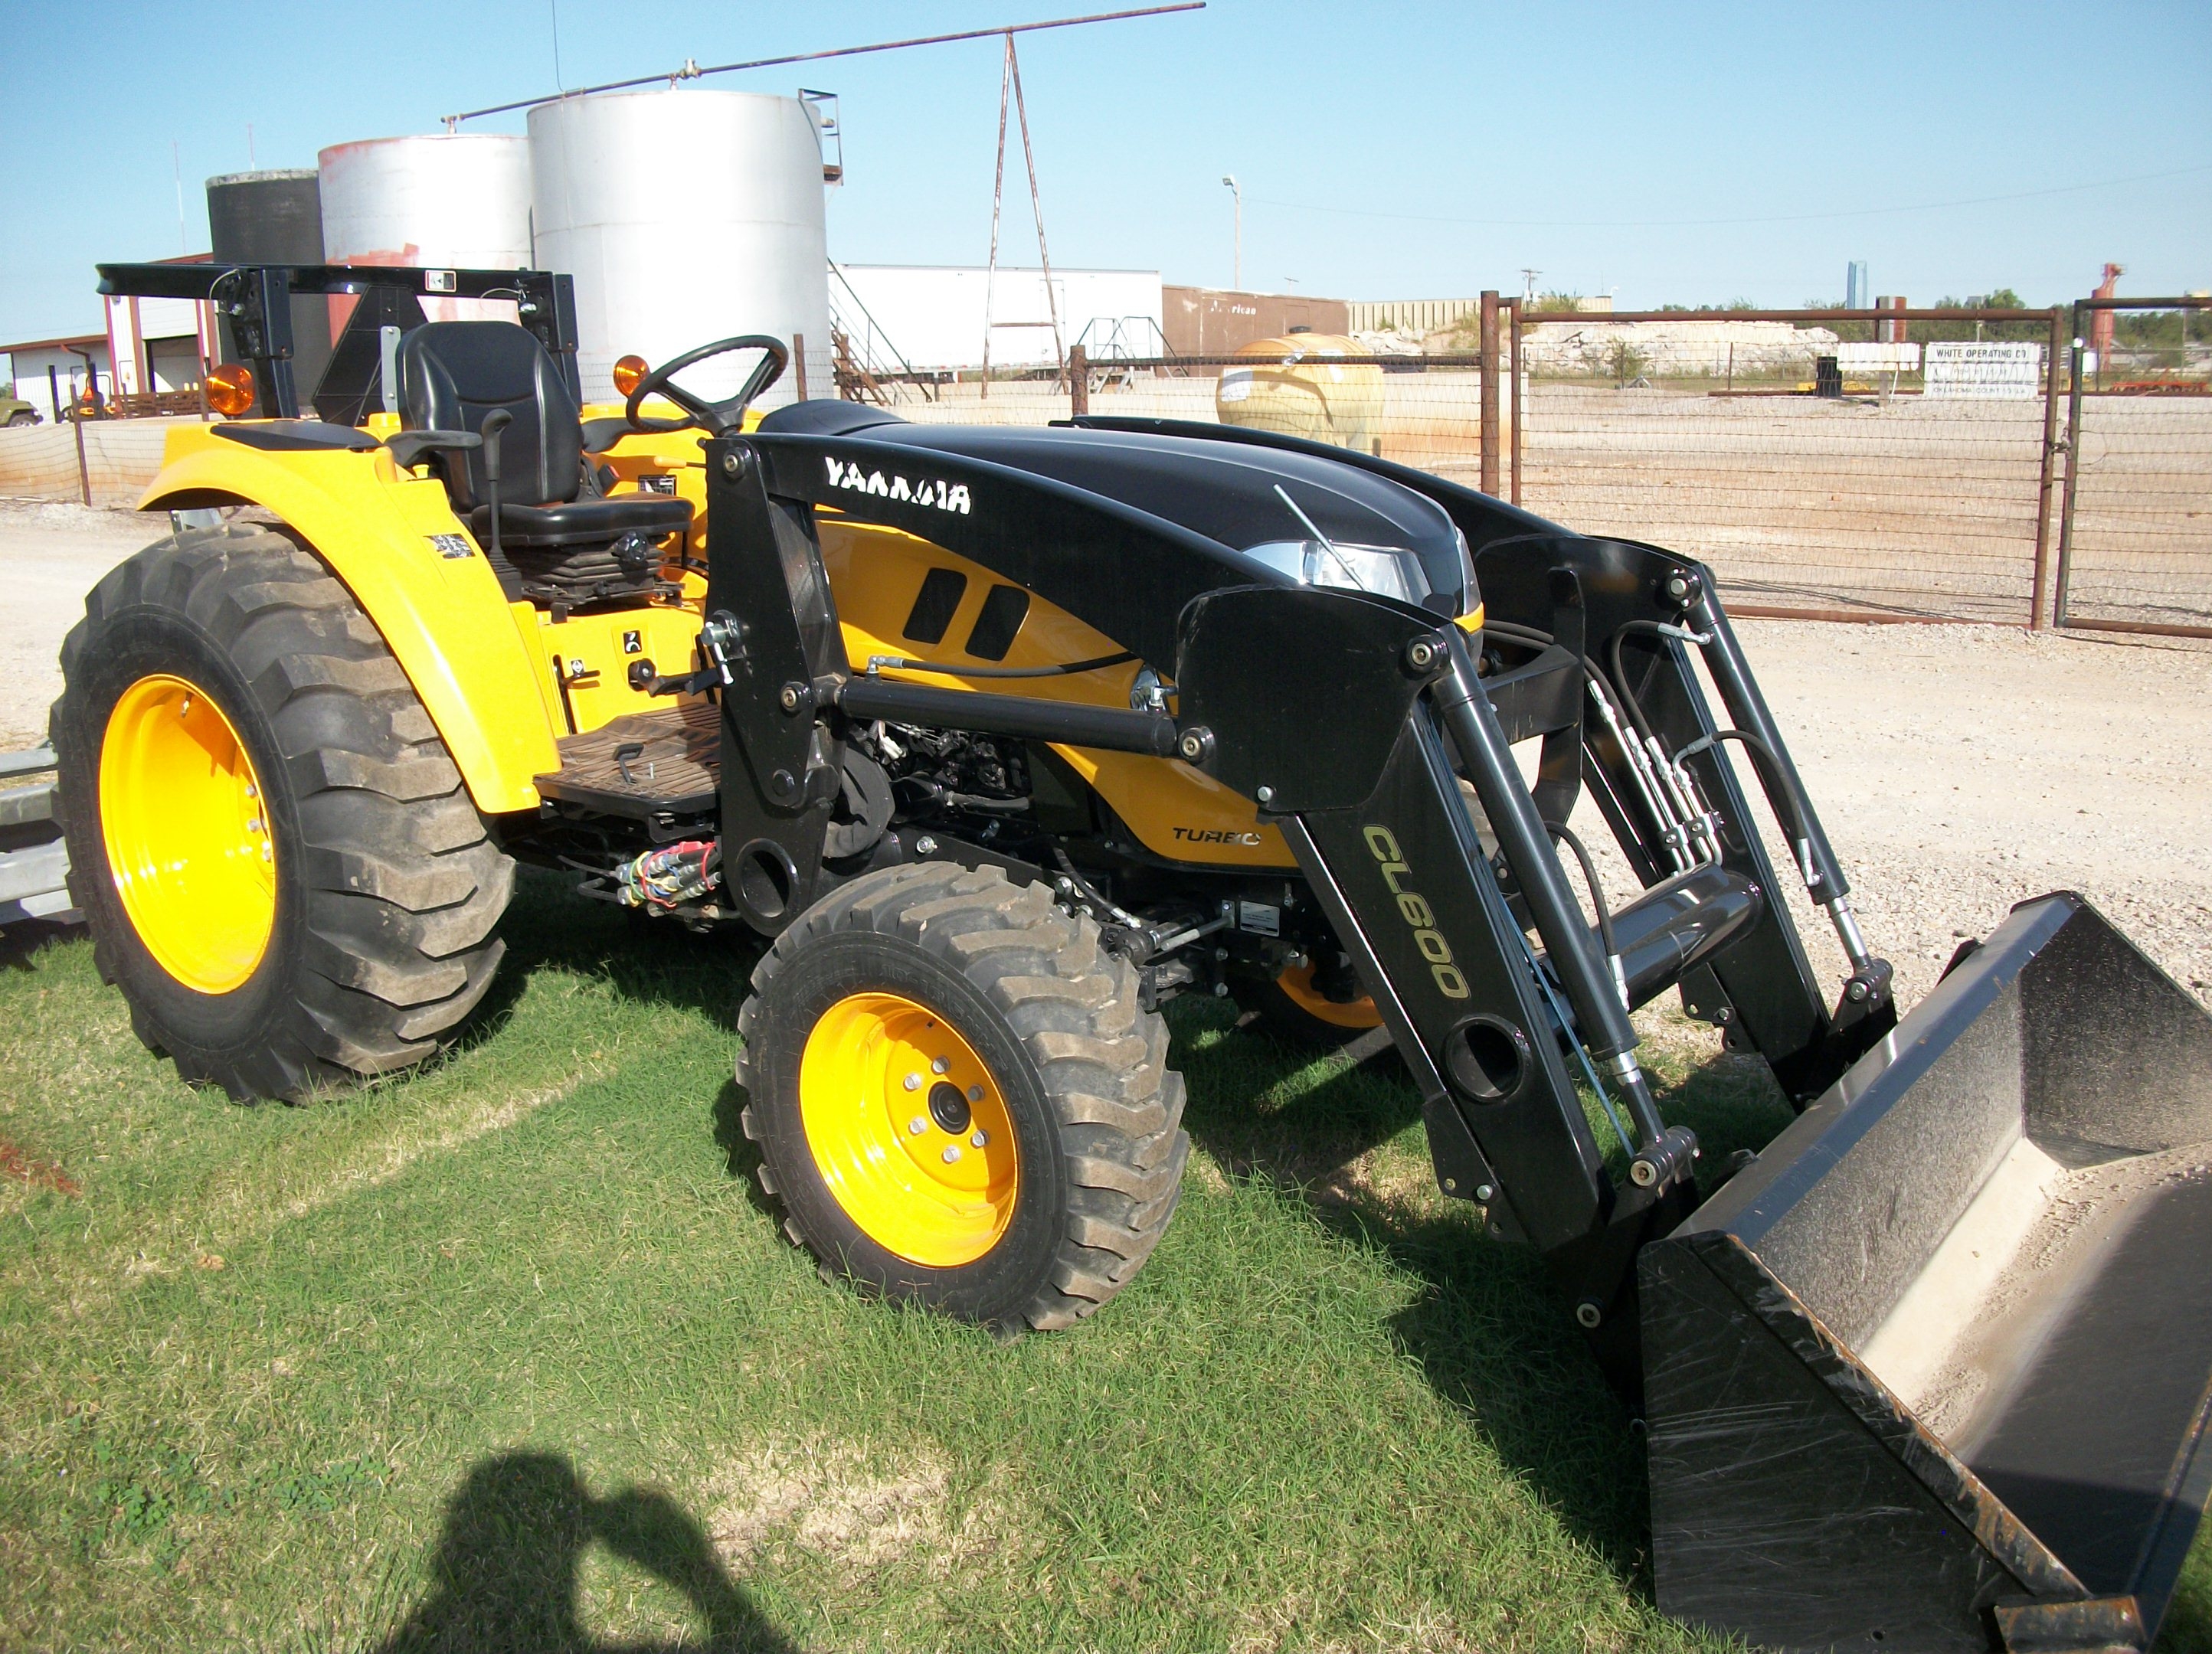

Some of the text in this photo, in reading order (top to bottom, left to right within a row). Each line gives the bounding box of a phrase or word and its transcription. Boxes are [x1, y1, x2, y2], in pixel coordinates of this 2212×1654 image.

[1936, 348, 1962, 358] WHITE
[1966, 349, 2011, 358] OPERATING
[1173, 827, 1261, 845] TURBO
[1363, 824, 1471, 999] CL600
